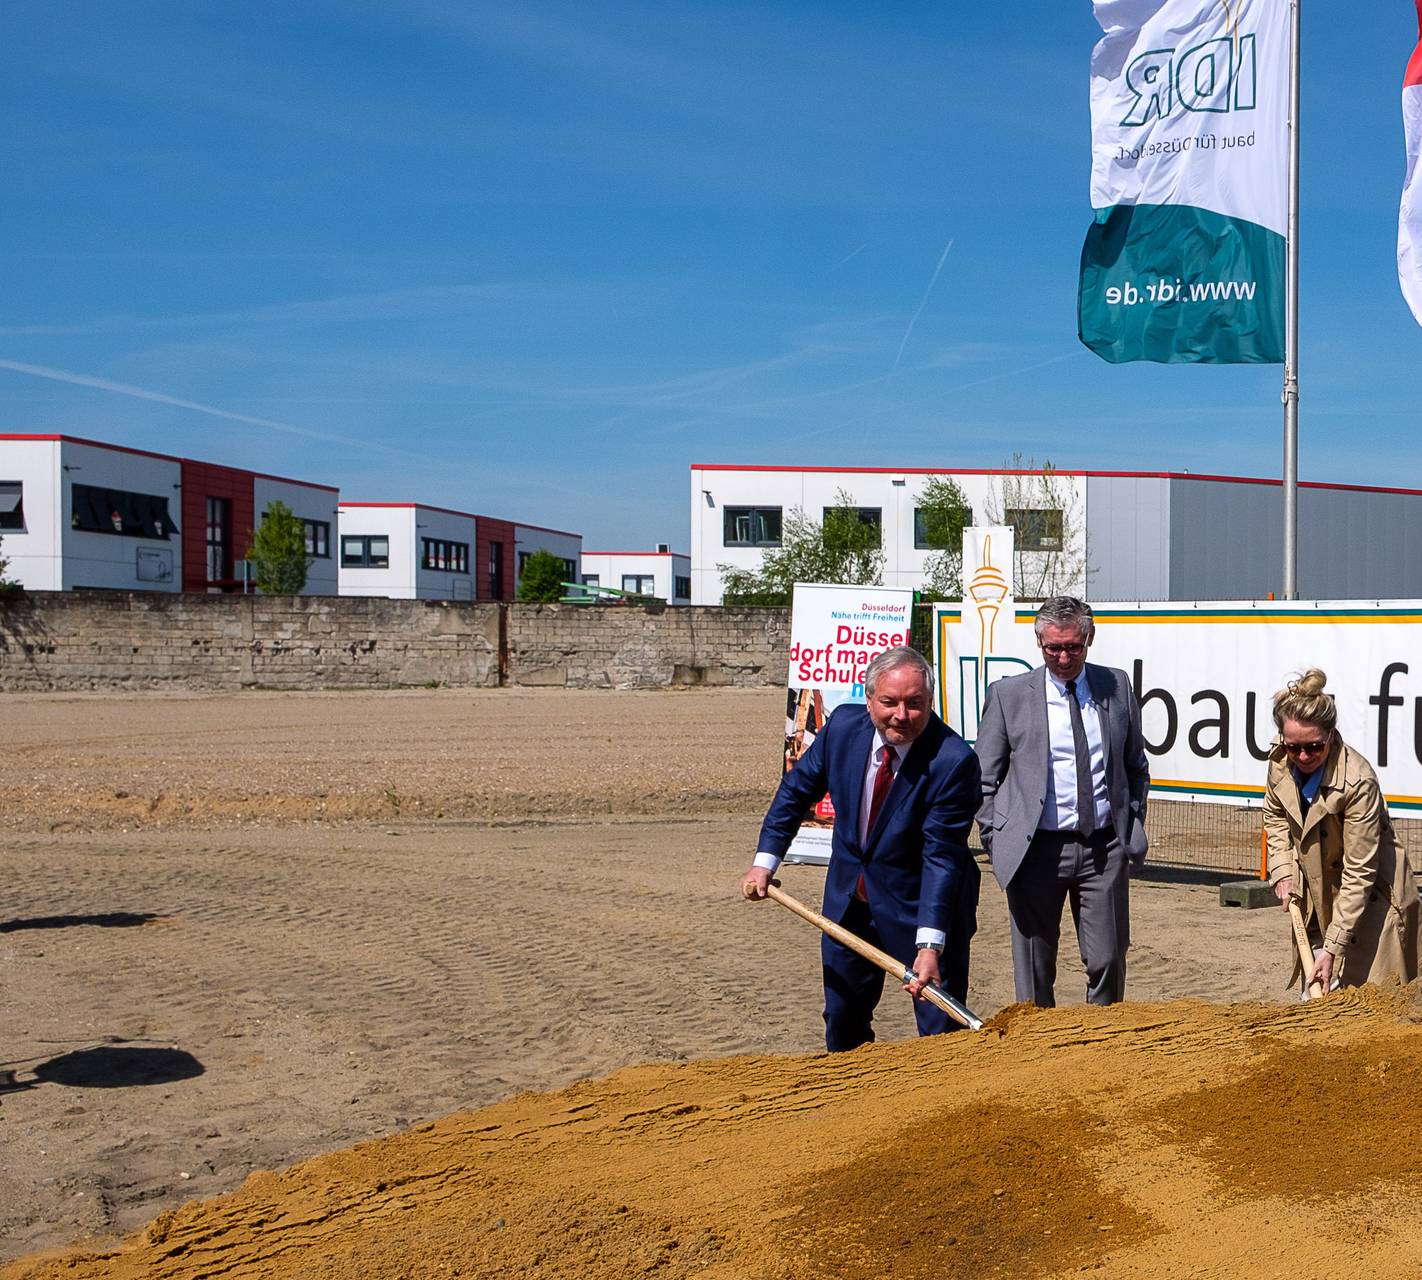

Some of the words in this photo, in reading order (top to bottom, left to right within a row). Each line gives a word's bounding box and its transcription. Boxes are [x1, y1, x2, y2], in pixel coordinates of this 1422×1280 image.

[831, 611, 852, 620] Nähe
[872, 613, 905, 622] Freiheit
[861, 603, 906, 613] Düsseldorf
[836, 625, 911, 648] Düssel
[790, 642, 833, 664] dorf
[1133, 658, 1335, 762] bau
